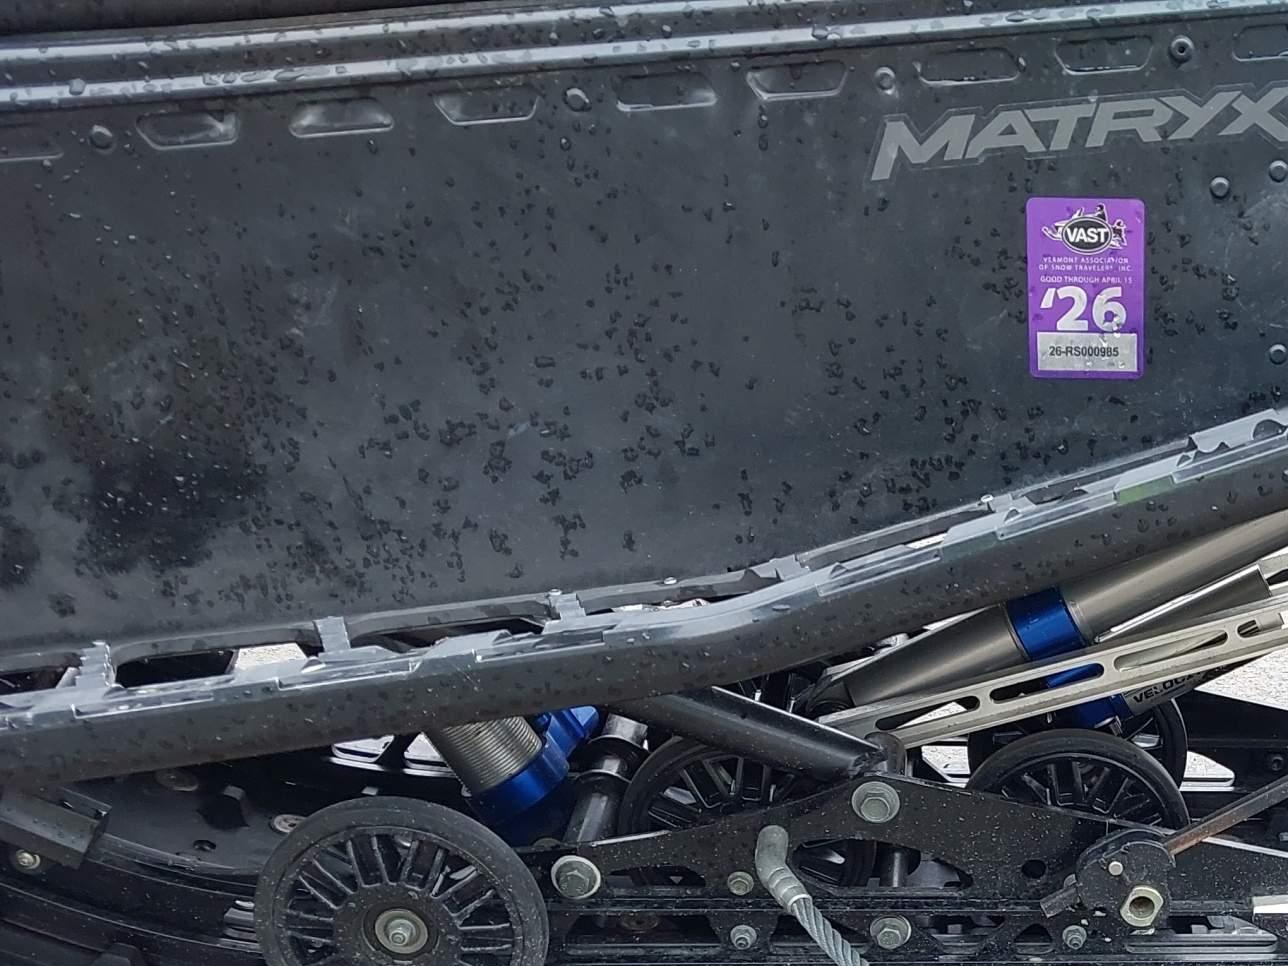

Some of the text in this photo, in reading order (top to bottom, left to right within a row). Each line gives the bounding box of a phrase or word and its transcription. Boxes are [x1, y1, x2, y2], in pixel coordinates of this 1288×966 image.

[1066, 227, 1109, 243] VAST
[1040, 275, 1062, 283] GOOD
[1101, 276, 1121, 284] APRIL
[1049, 346, 1119, 357] 26-RS000985
